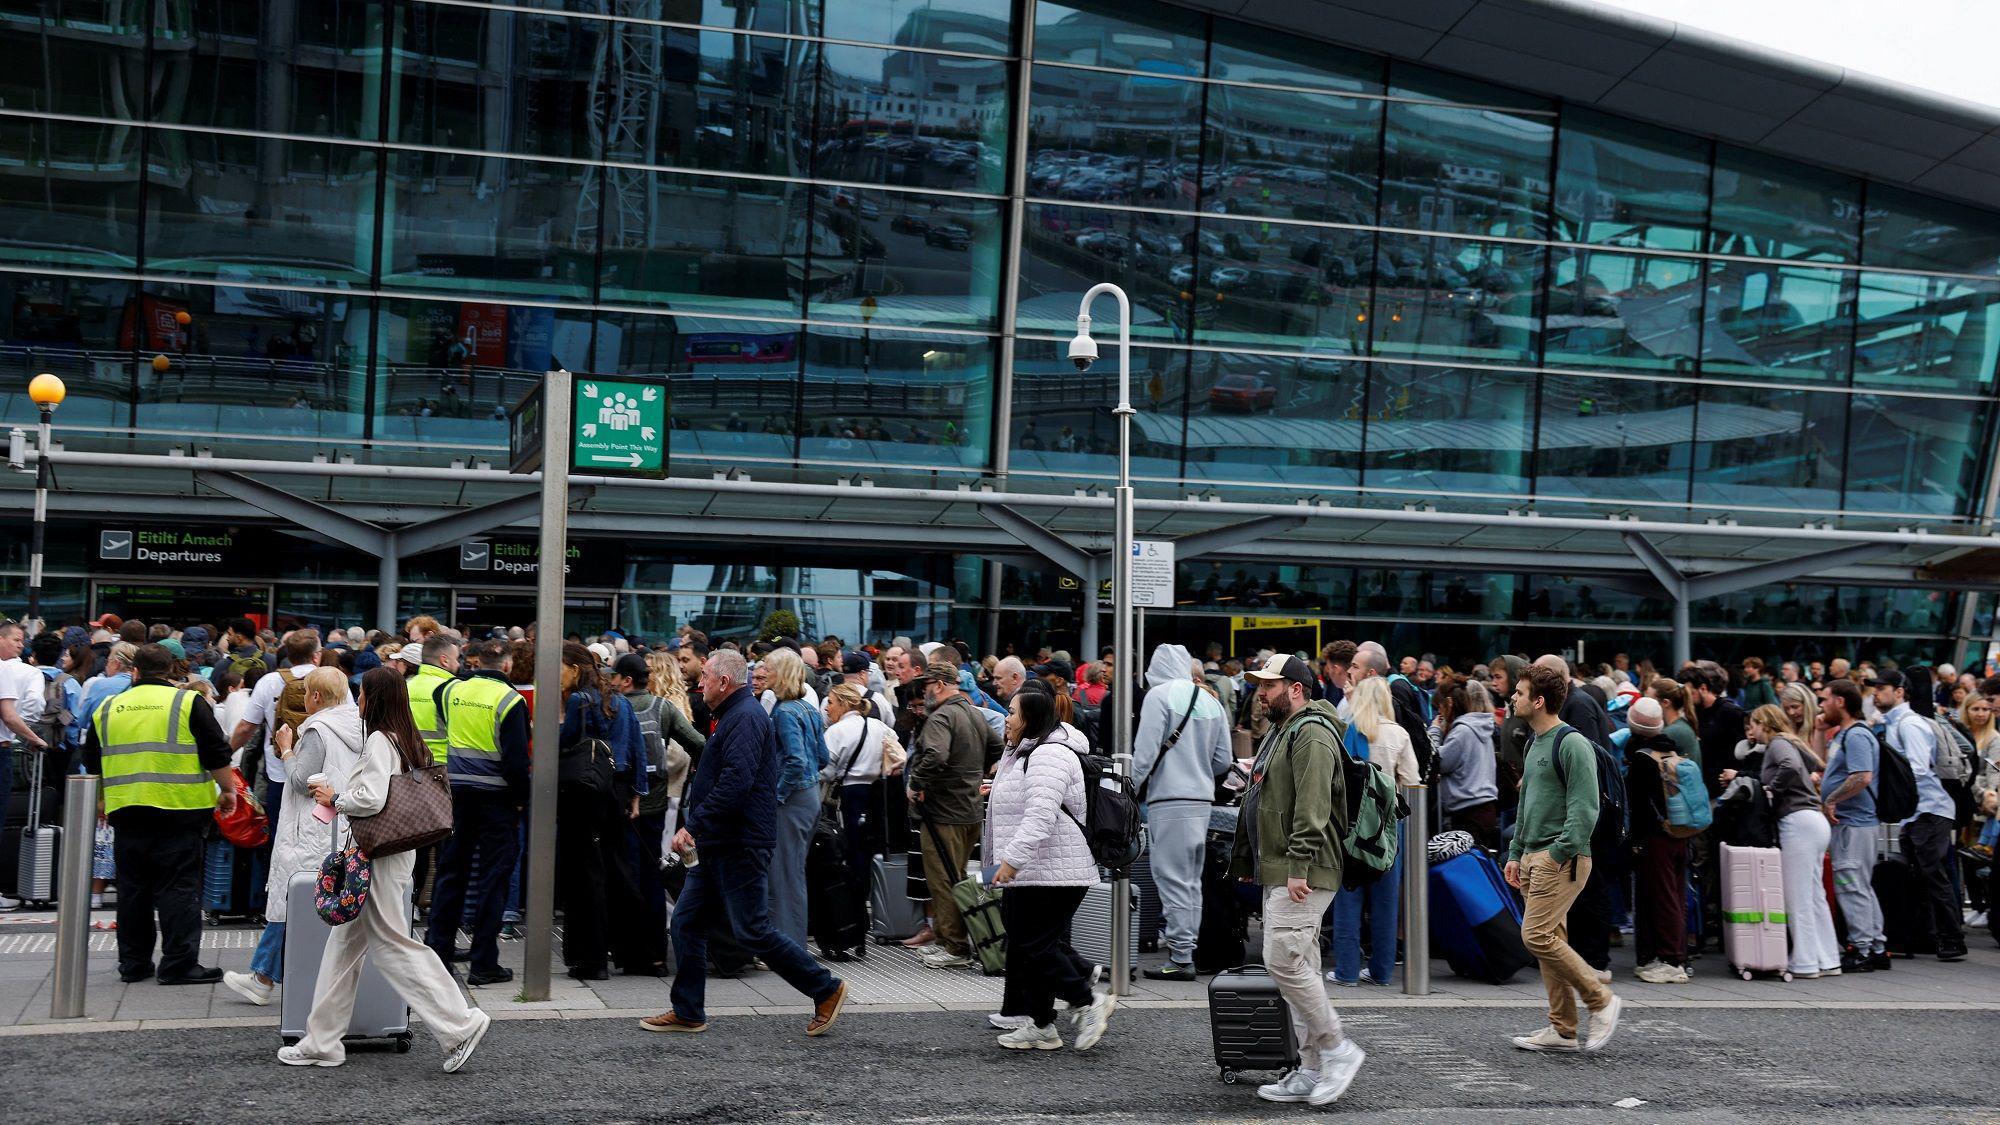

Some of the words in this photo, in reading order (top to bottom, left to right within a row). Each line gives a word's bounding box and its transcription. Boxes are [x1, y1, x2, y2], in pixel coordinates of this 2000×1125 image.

[578, 442, 609, 450] Assembly
[643, 445, 658, 453] Way
[181, 532, 232, 546] Amach
[137, 547, 222, 564] Departures
[534, 545, 580, 557] Ach
[494, 559, 571, 574] Depars
